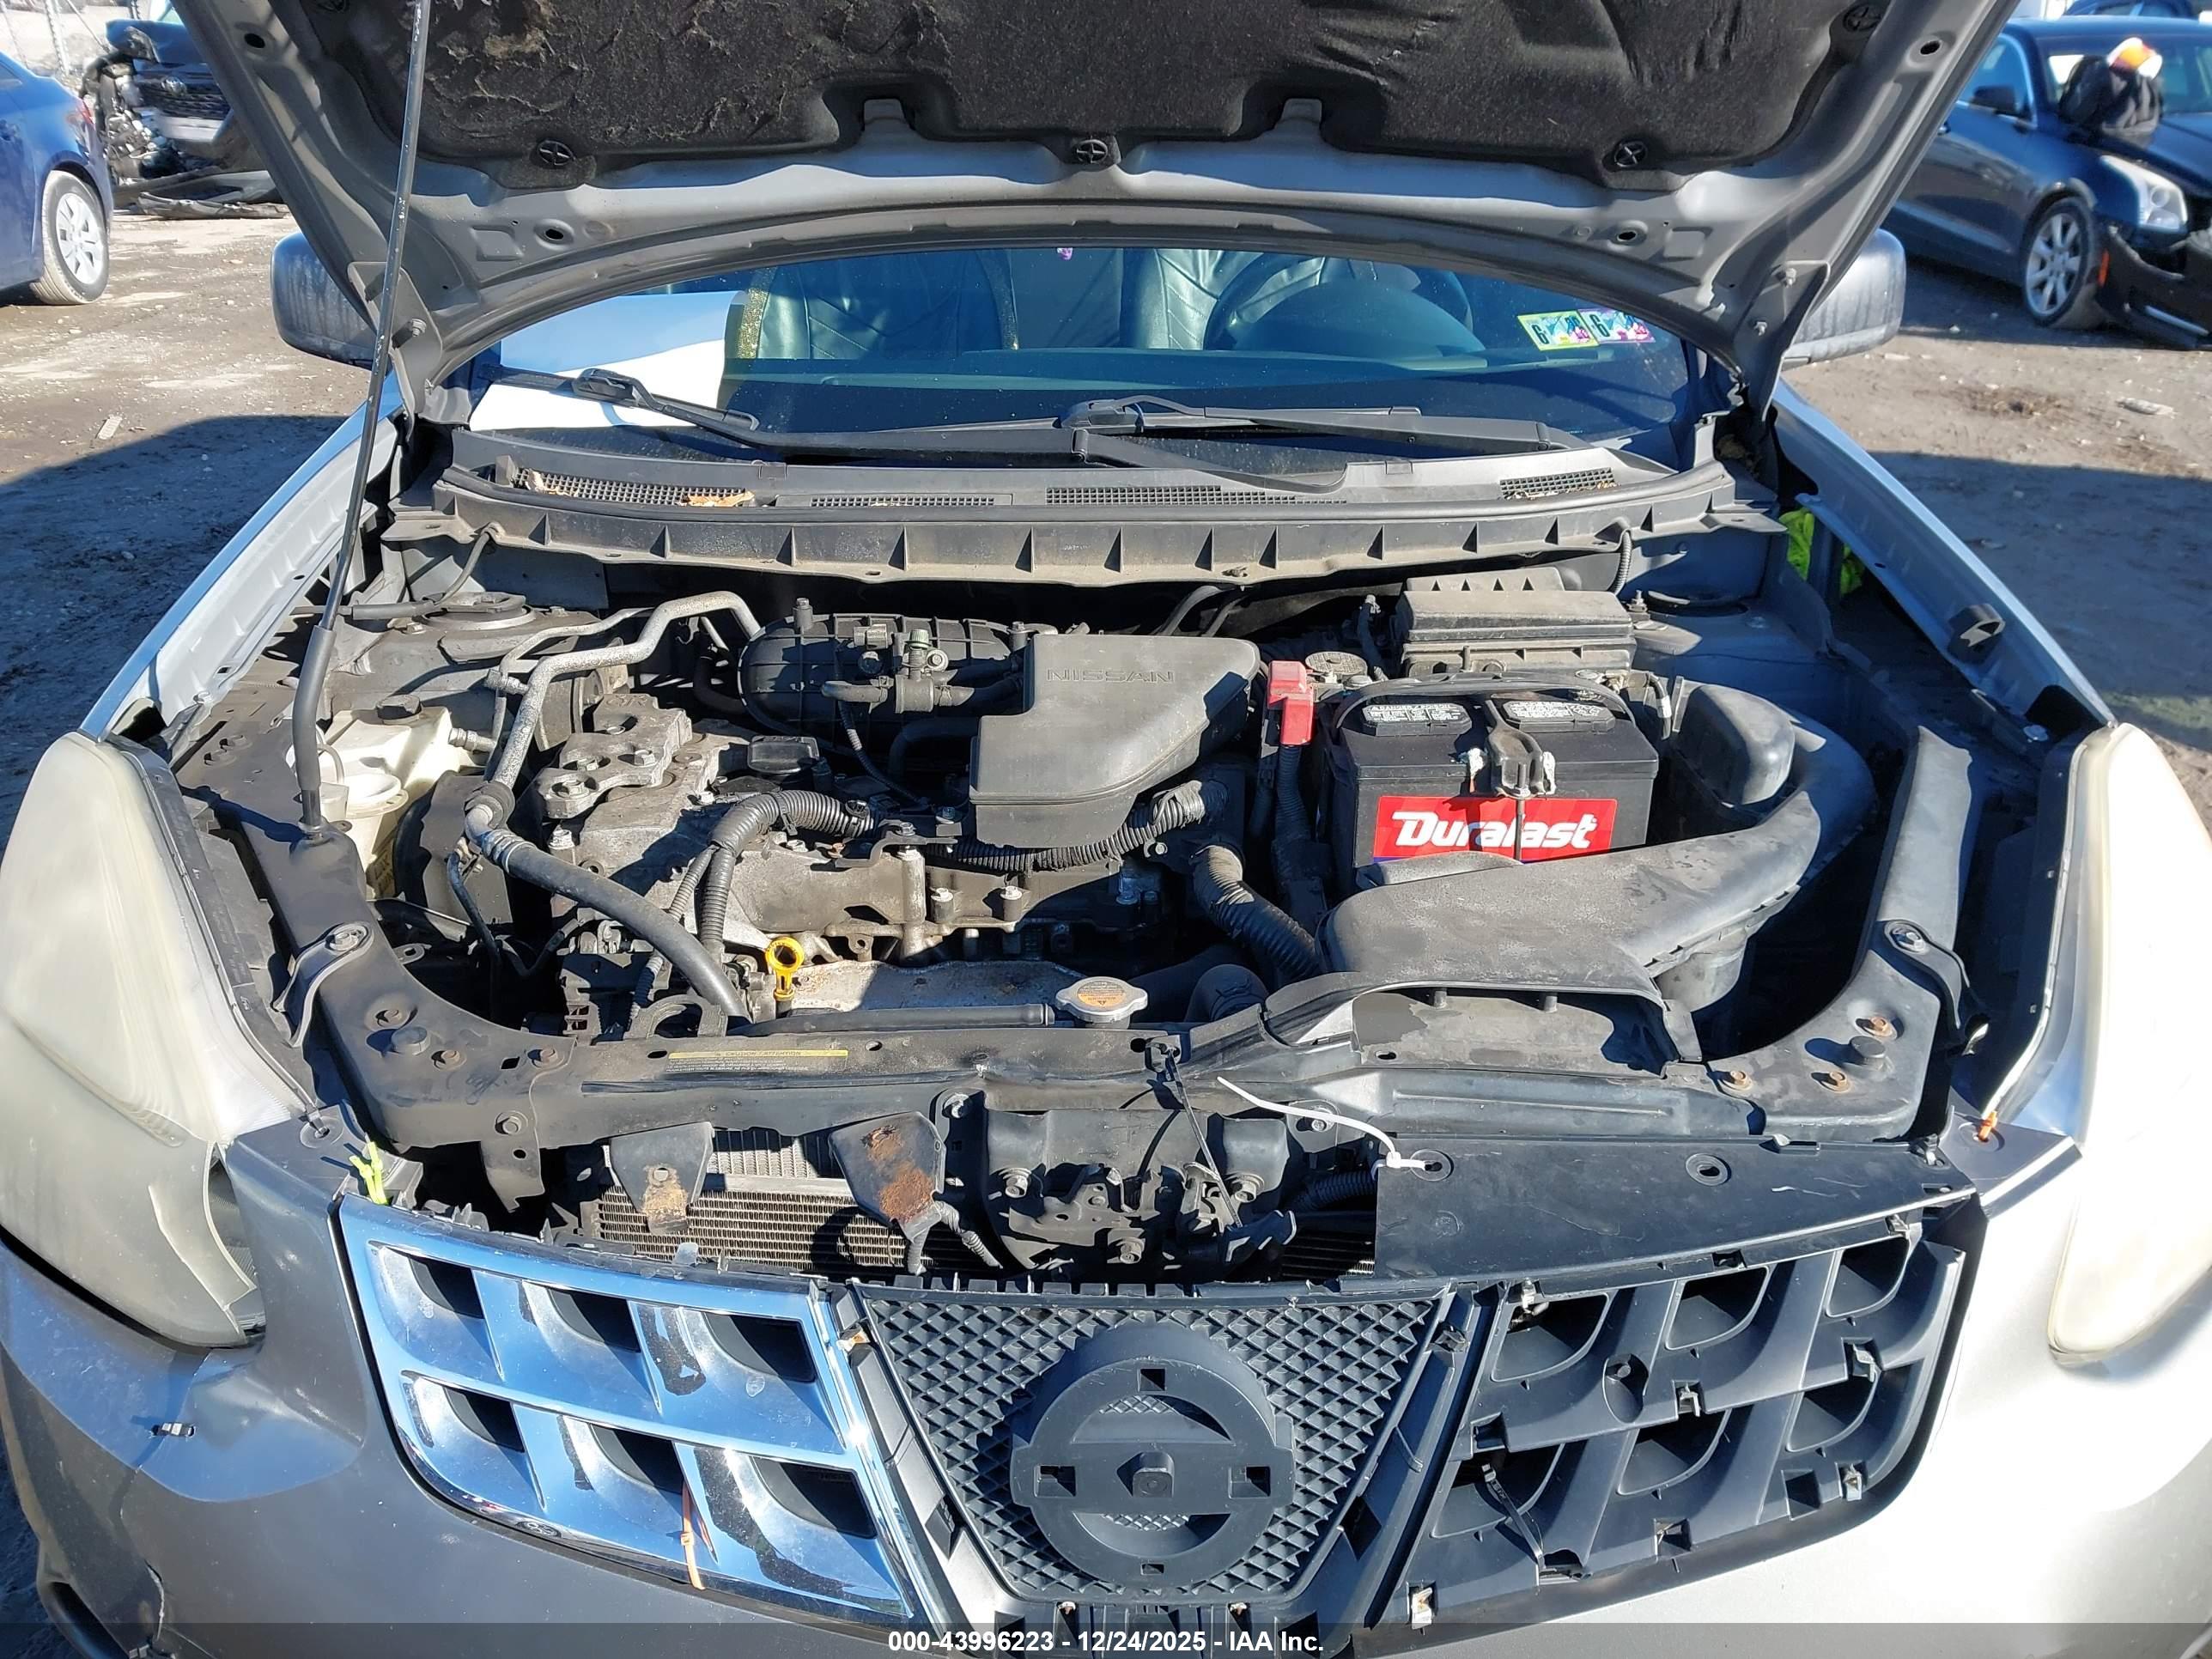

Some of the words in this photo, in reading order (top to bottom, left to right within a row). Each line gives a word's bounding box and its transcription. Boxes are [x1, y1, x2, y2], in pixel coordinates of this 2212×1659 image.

[1531, 325, 1549, 344] 6
[1589, 314, 1610, 337] 6
[1047, 669, 1175, 683] NISSAN
[1392, 811, 1598, 849] Duralast
